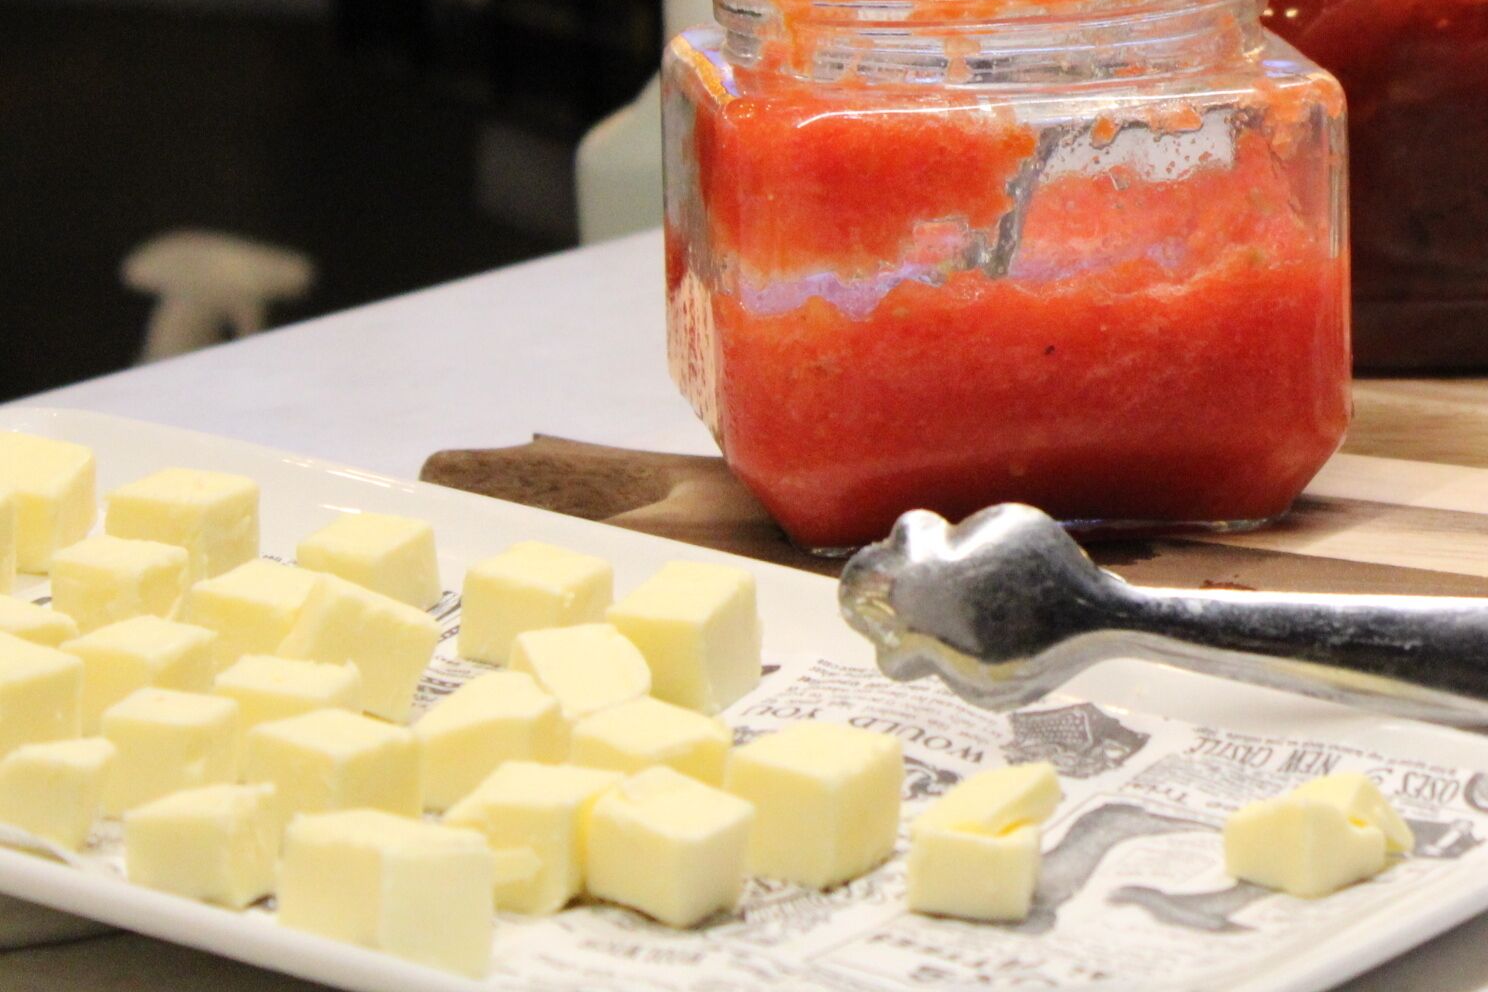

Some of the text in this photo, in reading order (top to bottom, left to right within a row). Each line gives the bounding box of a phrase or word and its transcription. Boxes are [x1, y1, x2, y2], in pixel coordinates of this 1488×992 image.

[741, 705, 985, 764] WOULD YOU
[1183, 736, 1273, 769] CASTLE
[1277, 748, 1341, 777] NEW
